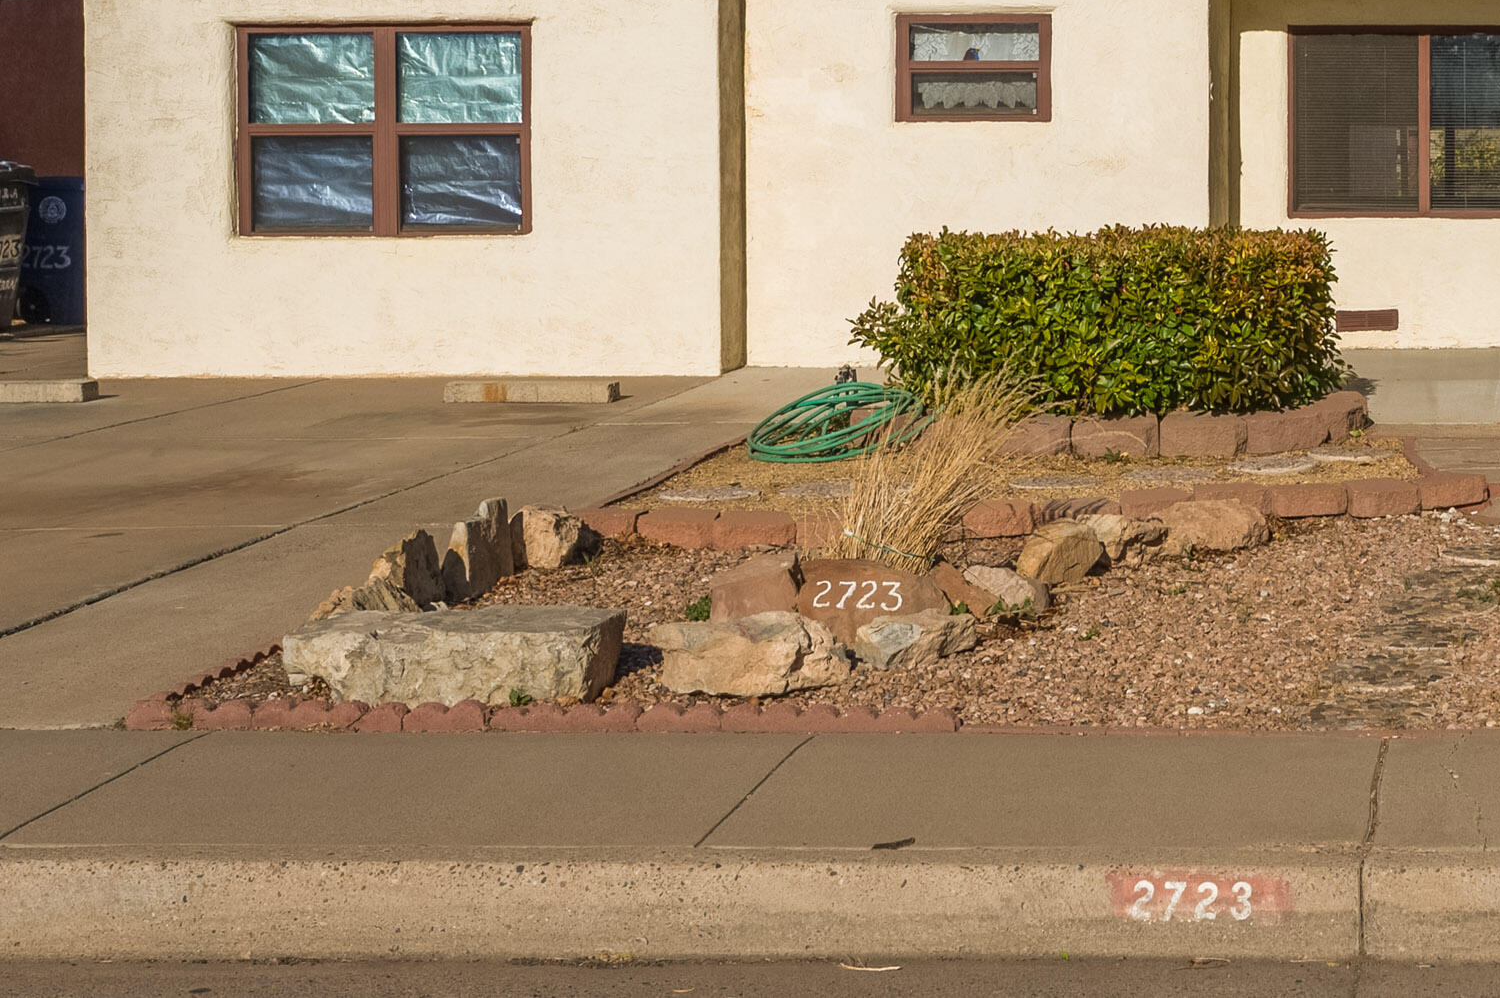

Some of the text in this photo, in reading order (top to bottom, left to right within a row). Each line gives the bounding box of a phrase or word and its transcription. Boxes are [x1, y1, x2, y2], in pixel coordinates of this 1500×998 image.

[0, 238, 20, 259] 23
[812, 580, 903, 612] 2723
[1131, 879, 1252, 922] 2723
